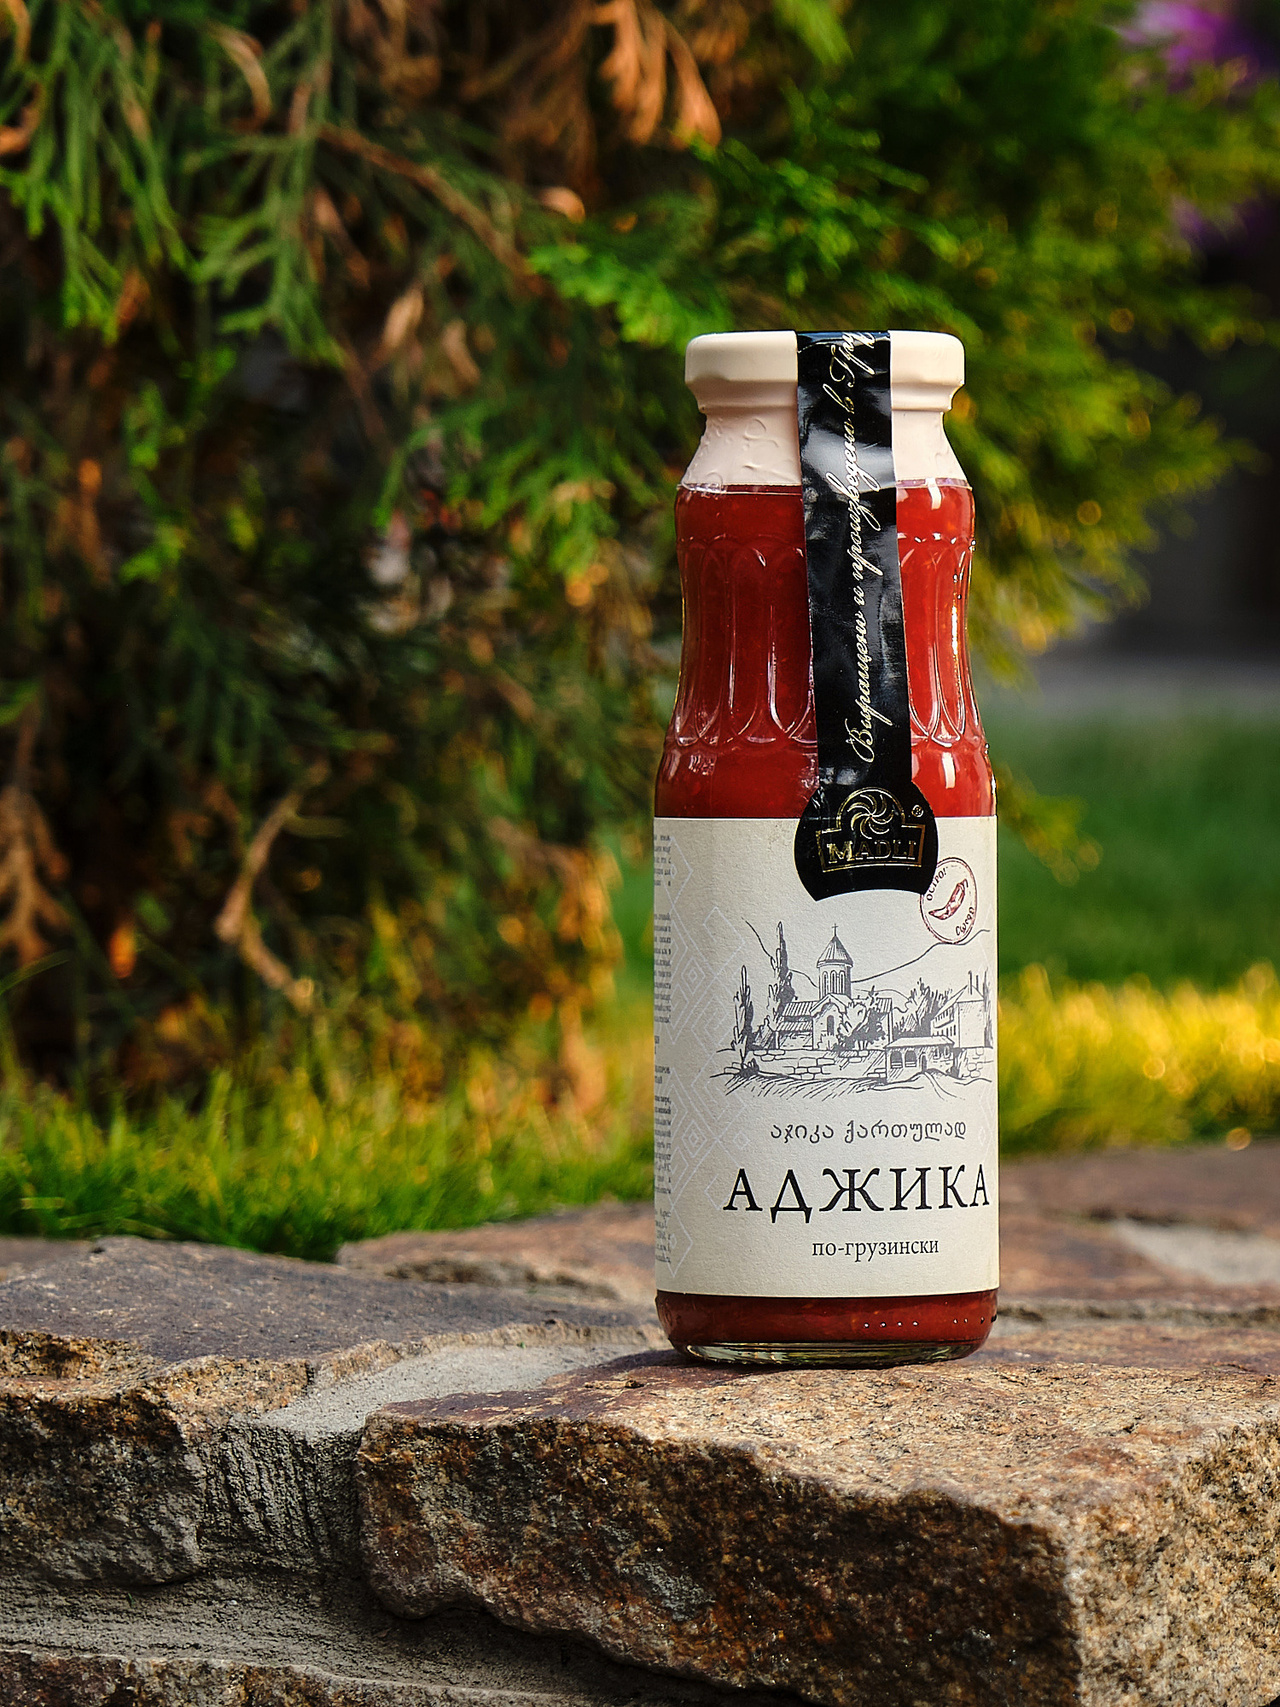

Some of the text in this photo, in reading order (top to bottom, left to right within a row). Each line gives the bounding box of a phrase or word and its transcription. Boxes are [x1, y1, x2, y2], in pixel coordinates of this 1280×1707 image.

[823, 383, 855, 415] в
[825, 418, 883, 581] произведено
[853, 585, 866, 606] и
[826, 840, 917, 865] MADLI
[769, 1118, 967, 1144] აჯიკა ქართულად
[722, 1163, 990, 1224] АДЖИКА
[811, 1239, 939, 1263] по-грузински
